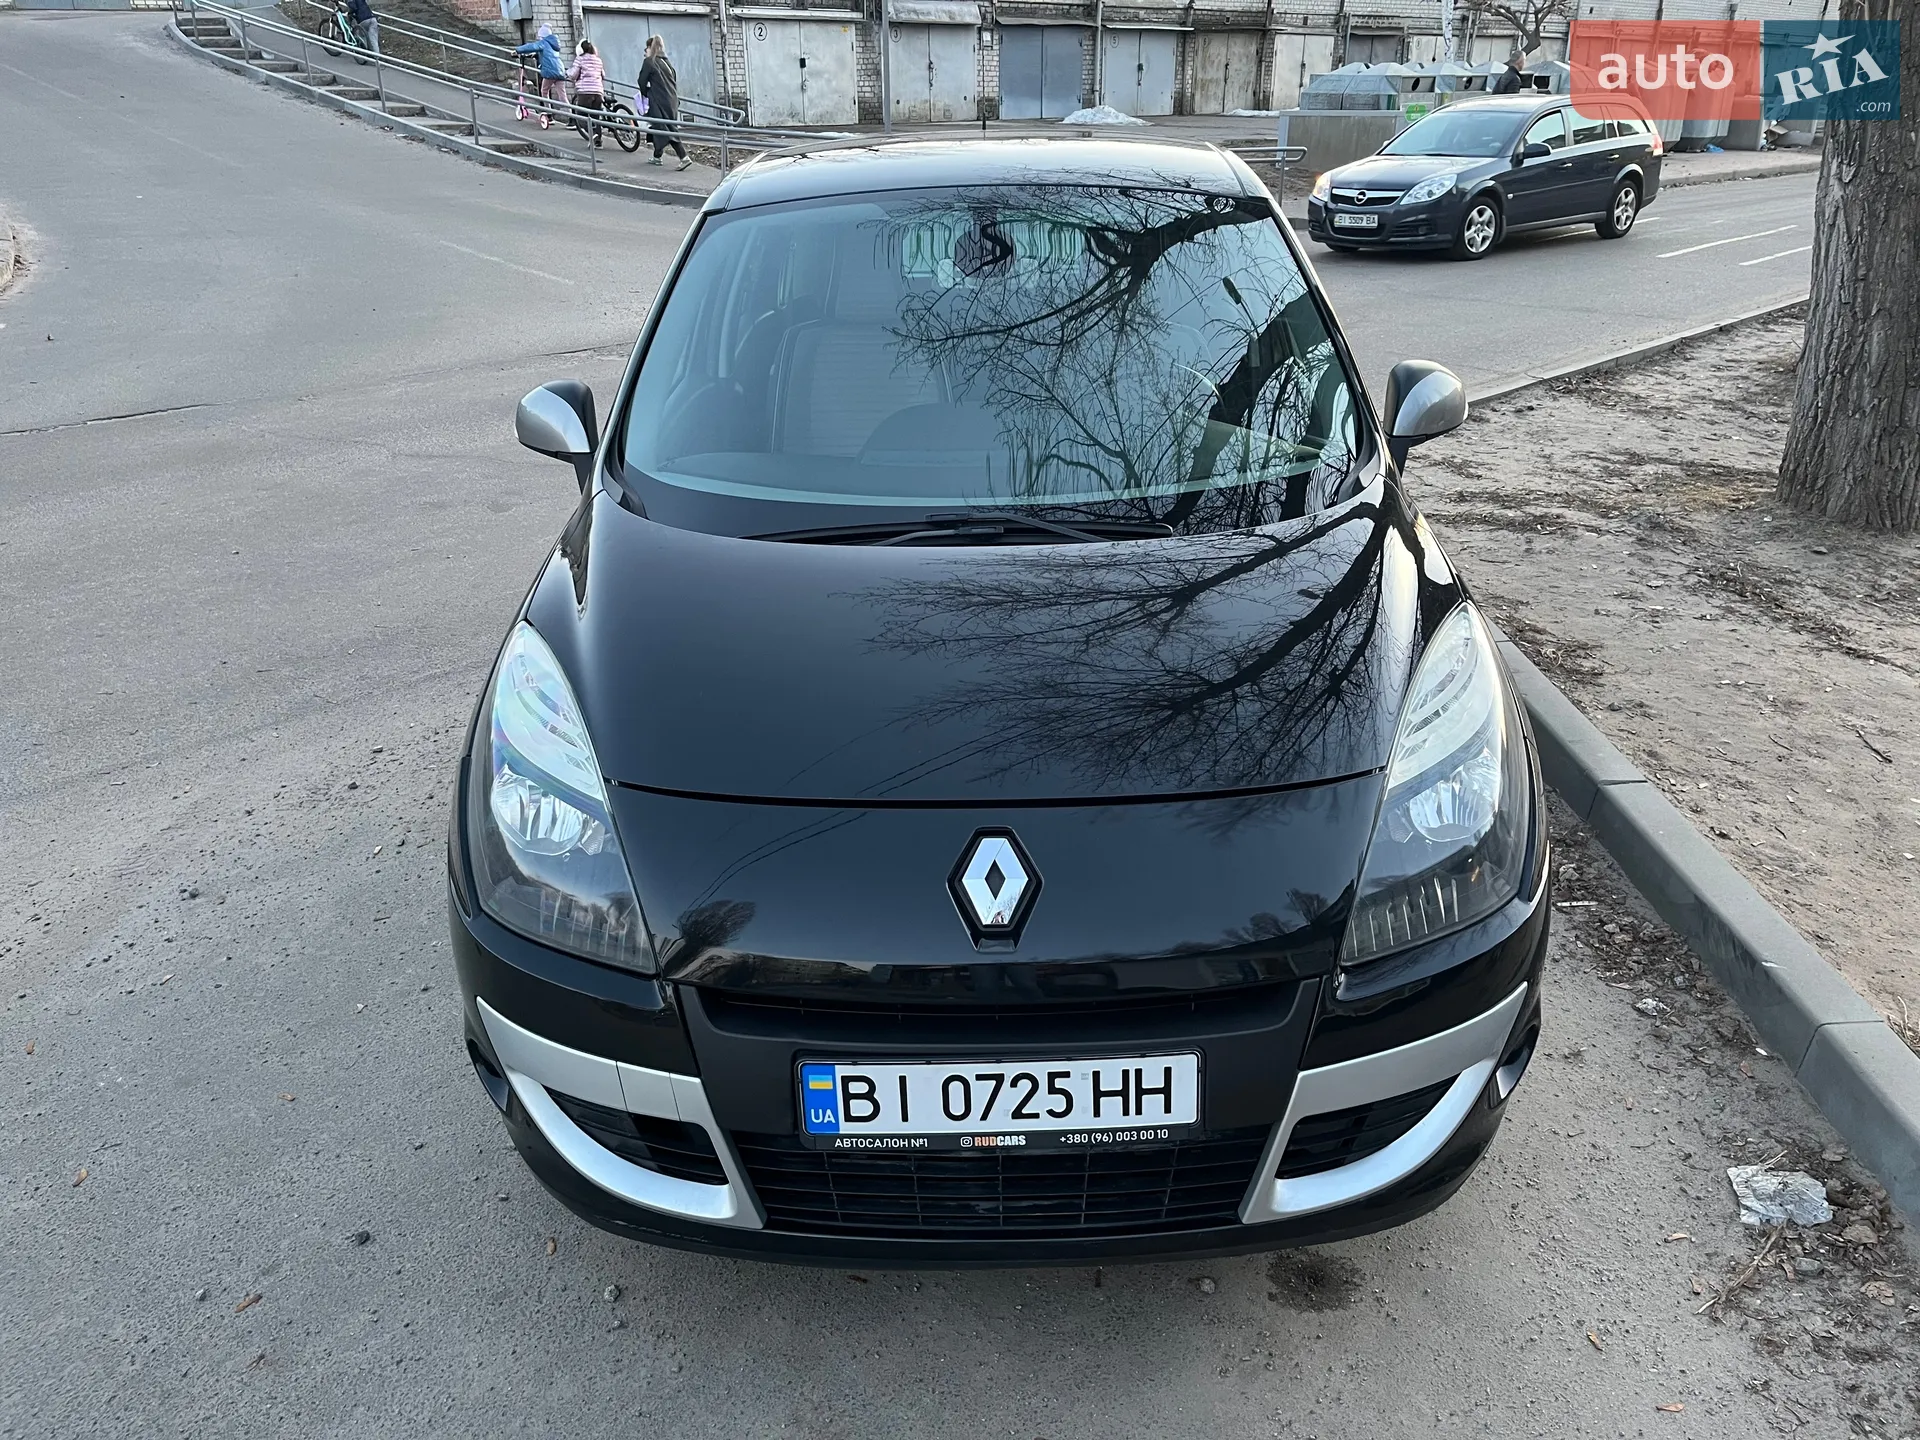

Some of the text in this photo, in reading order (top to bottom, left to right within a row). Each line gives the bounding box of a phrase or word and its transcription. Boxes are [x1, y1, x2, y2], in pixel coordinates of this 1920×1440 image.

[941, 1071, 1074, 1122] 0725
[1092, 1066, 1173, 1118] HH
[811, 1108, 835, 1123] UA
[834, 1138, 908, 1148] АВТОСАЛОН
[974, 1135, 1026, 1147] RUDCARS
[1060, 1128, 1169, 1145] +380 (96) 003 00 10
